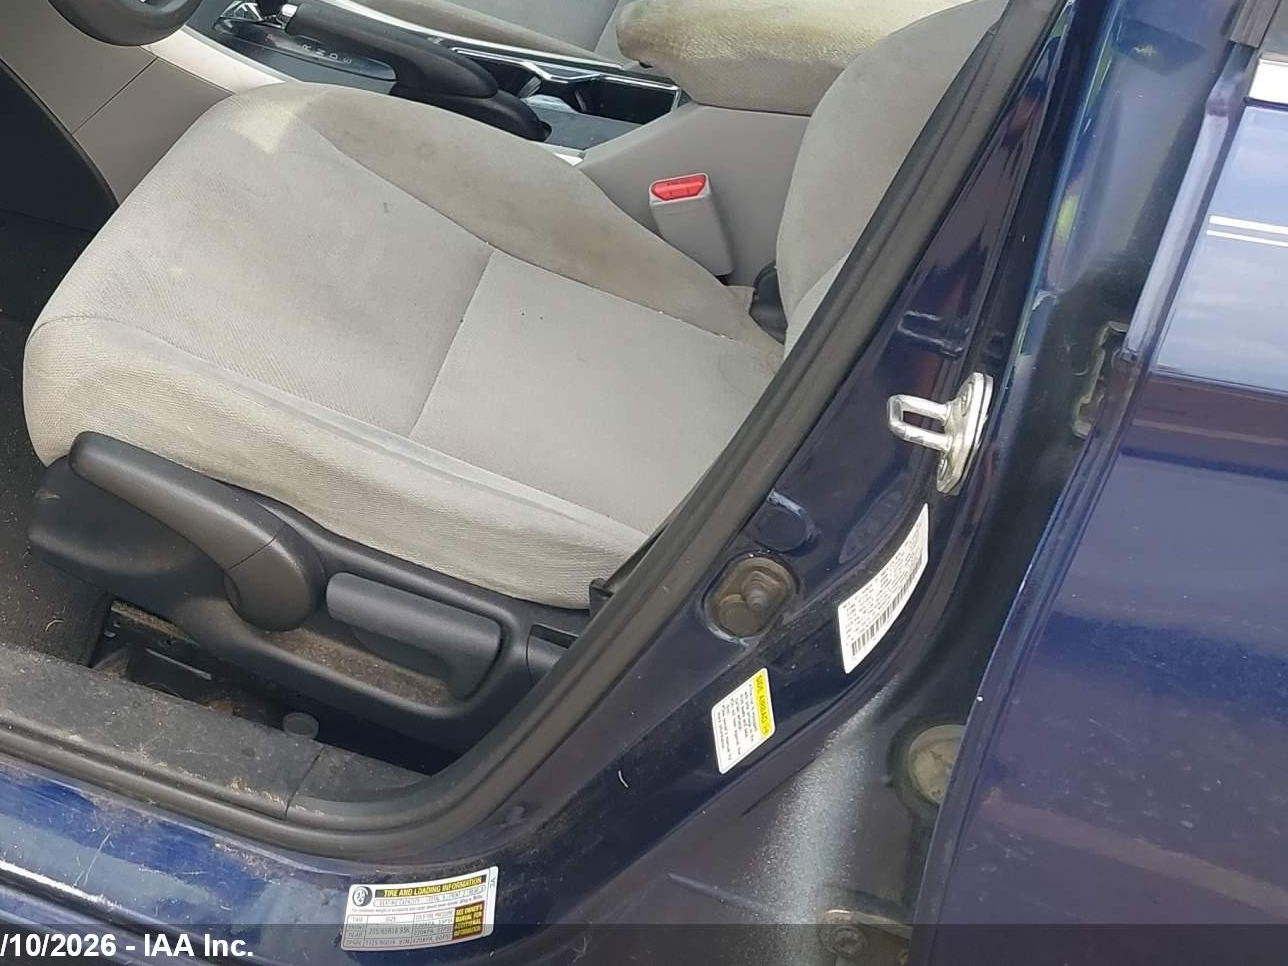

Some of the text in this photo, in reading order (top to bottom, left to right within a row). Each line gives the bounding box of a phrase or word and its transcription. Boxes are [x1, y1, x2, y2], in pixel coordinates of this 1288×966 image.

[383, 889, 398, 897] TIRE
[399, 888, 413, 897] AND
[414, 884, 441, 895] LOADING
[442, 877, 483, 893] INFORMATION
